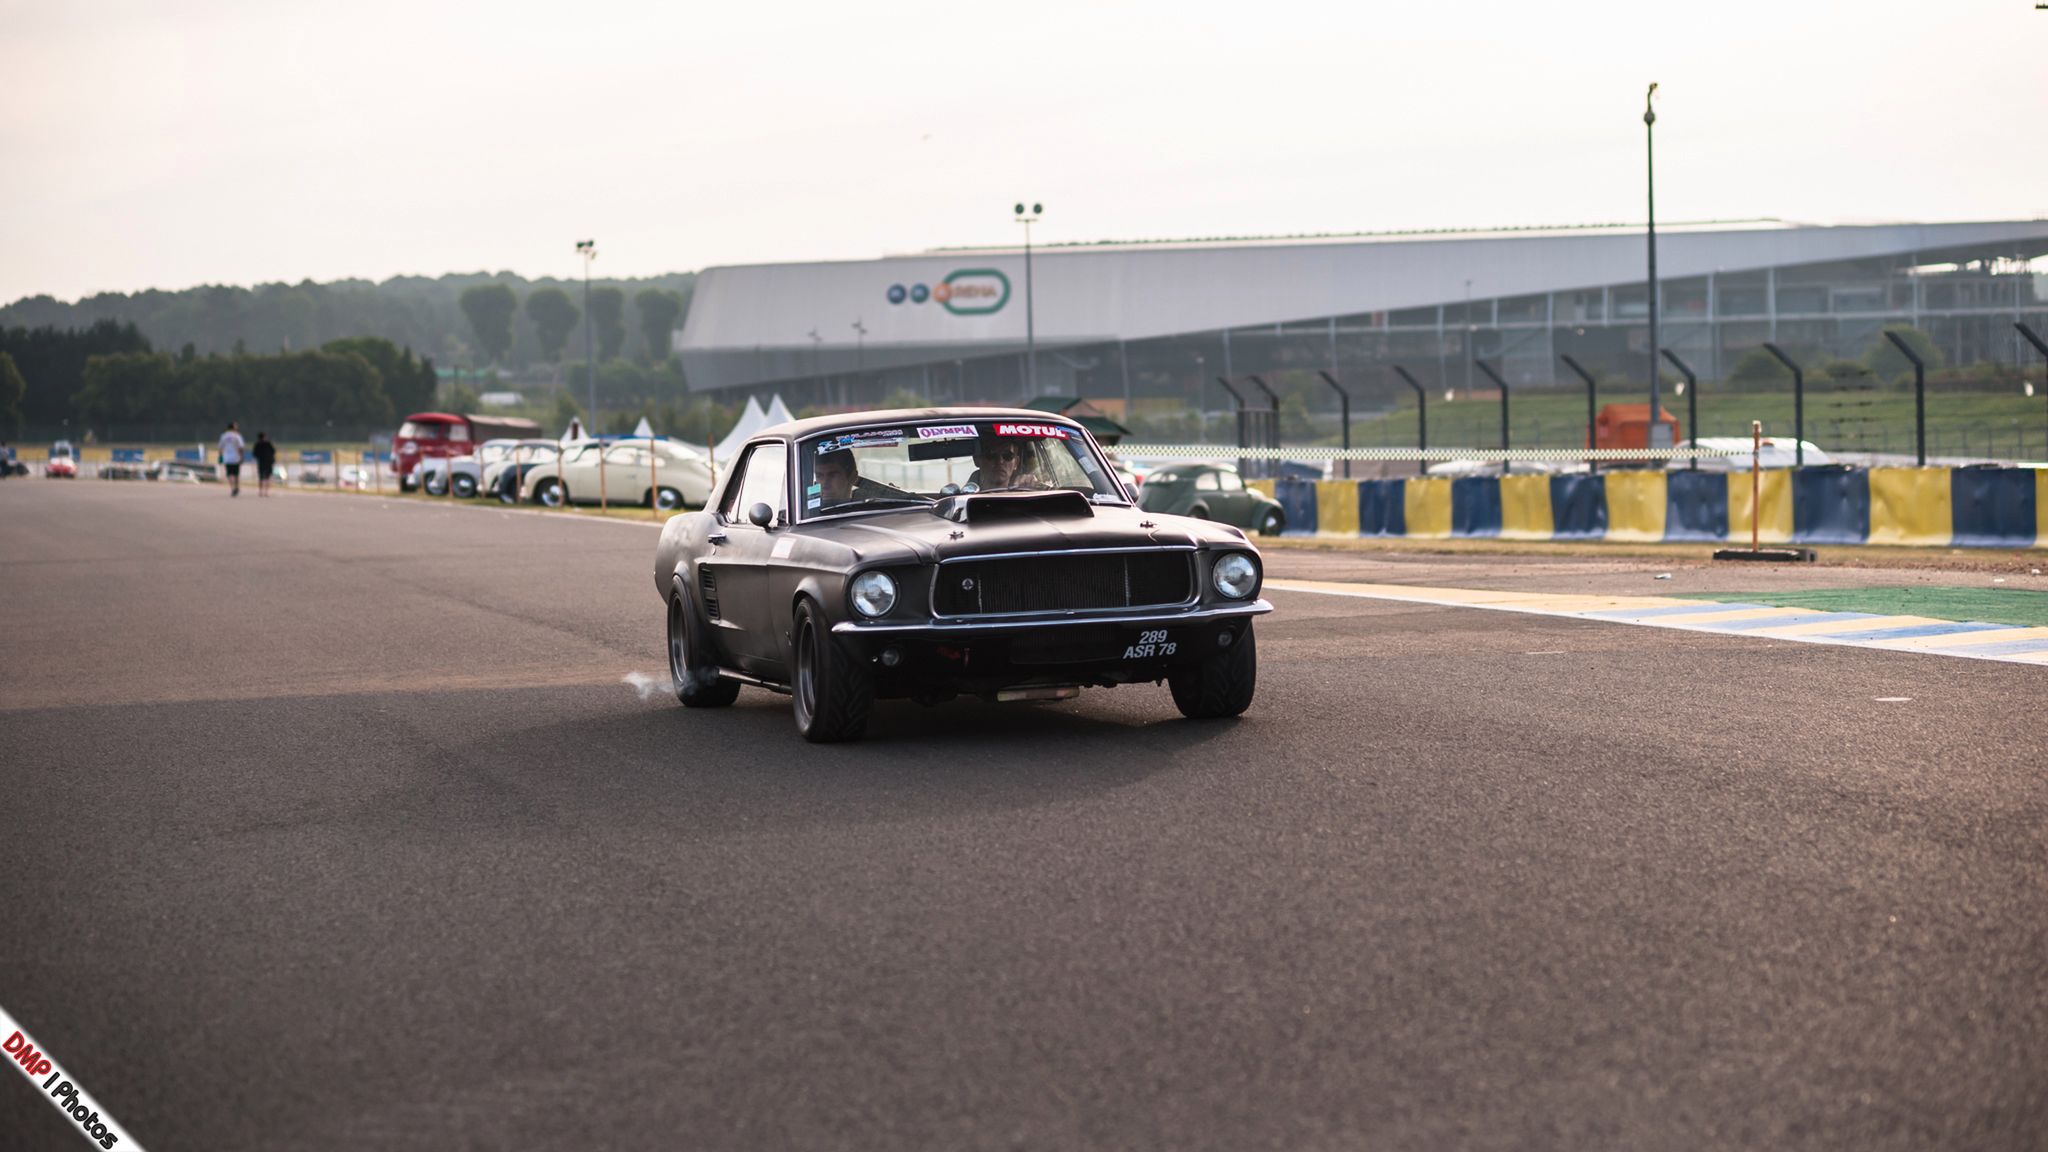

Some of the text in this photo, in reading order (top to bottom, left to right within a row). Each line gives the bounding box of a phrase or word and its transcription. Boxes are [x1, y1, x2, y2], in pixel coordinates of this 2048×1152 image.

[920, 426, 976, 438] OLYMPIA
[999, 425, 1066, 437] MOTUL
[1139, 630, 1168, 644] 289
[1122, 642, 1177, 659] ASR 78
